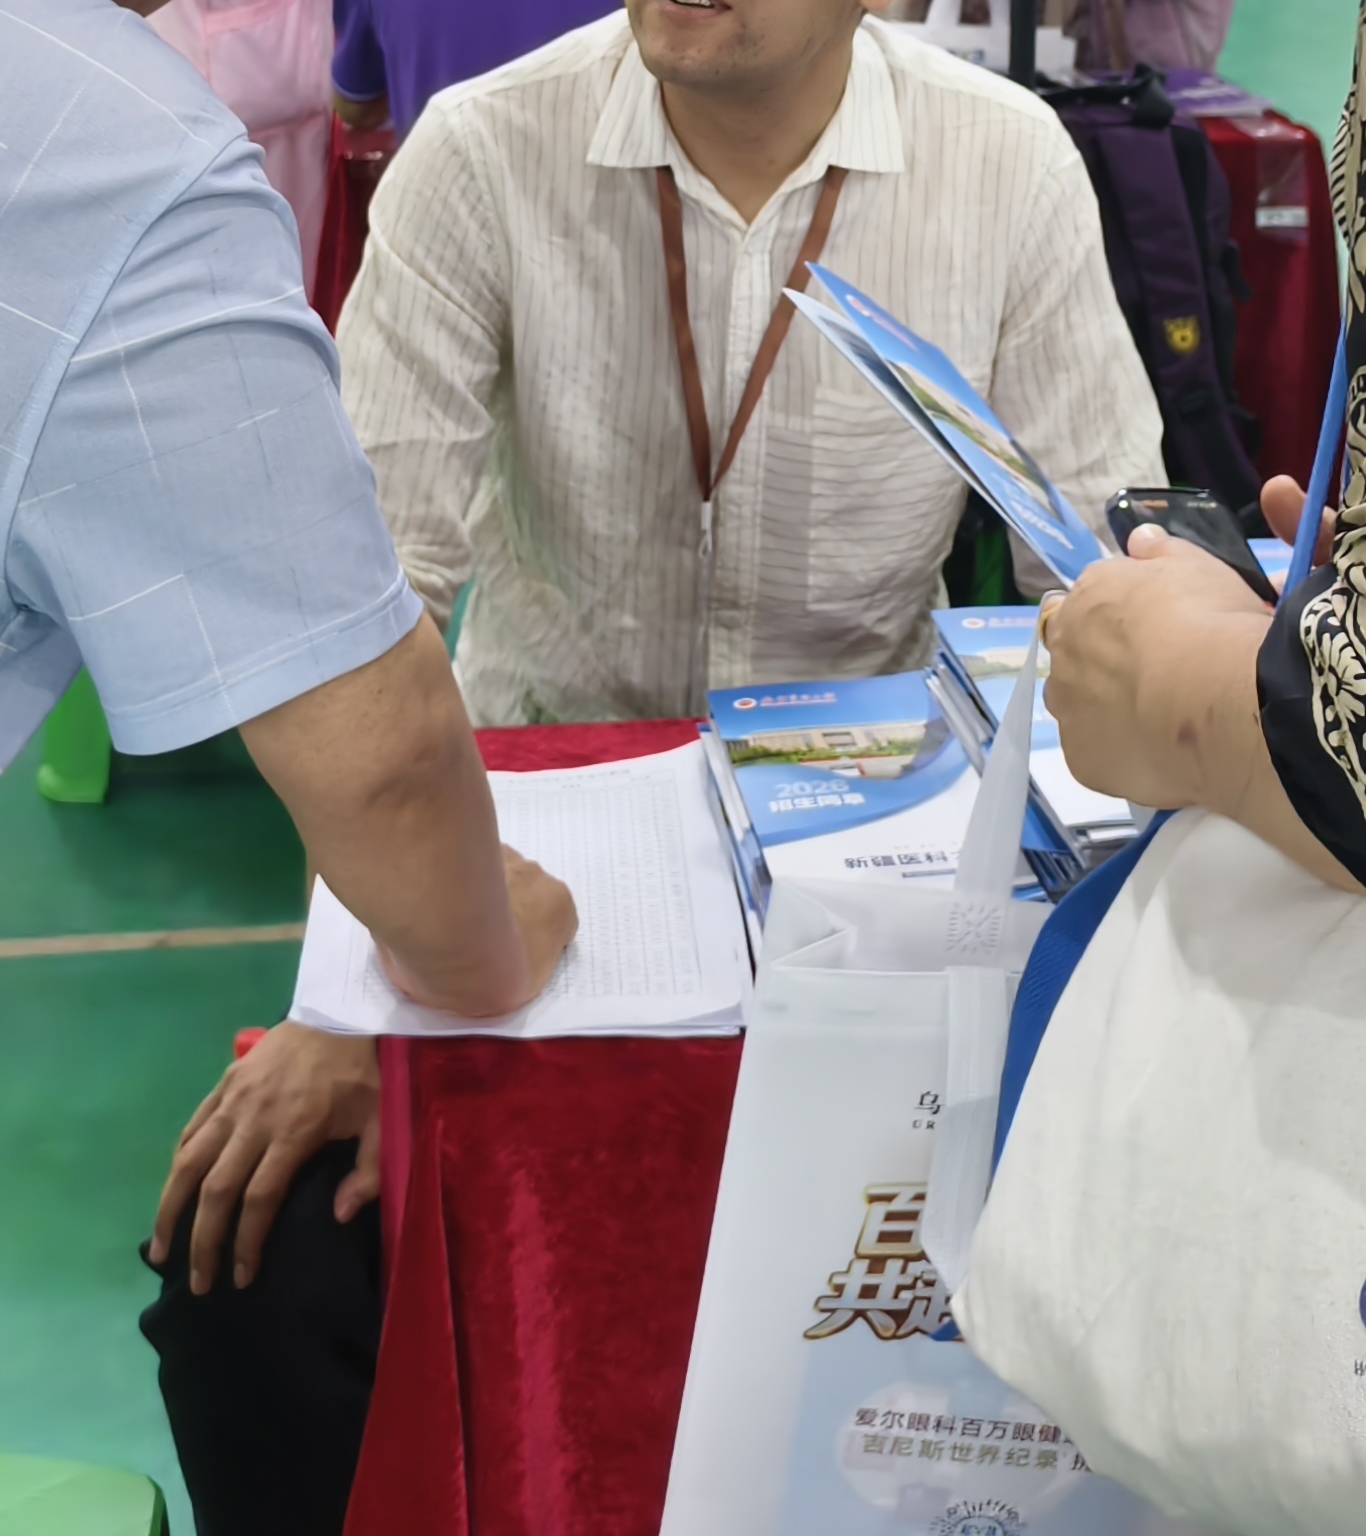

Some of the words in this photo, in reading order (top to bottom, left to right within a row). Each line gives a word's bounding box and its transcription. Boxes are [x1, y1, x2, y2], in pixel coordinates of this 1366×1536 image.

[854, 1407, 1073, 1446] 爱尔眼科百万眼健
